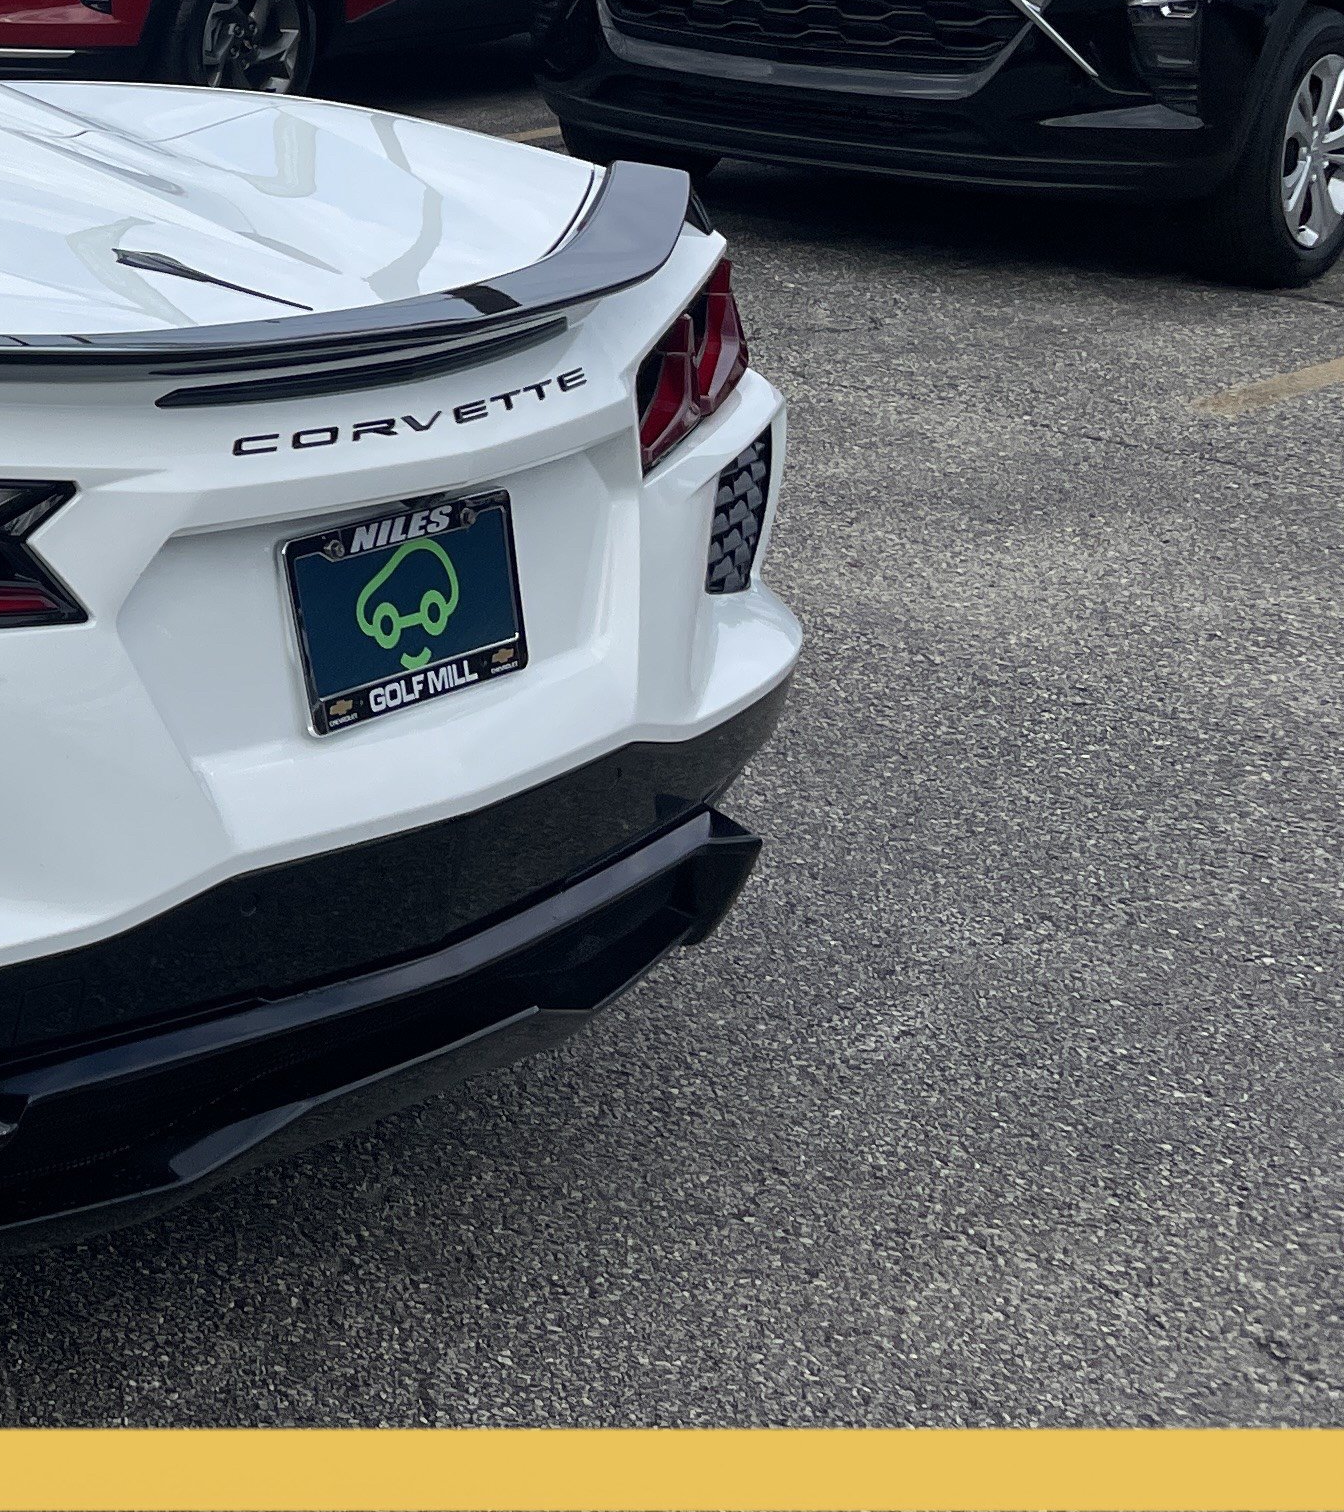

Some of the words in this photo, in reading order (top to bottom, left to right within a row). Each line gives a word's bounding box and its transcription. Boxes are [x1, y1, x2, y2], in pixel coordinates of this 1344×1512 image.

[232, 367, 588, 457] CORVETTE
[349, 505, 451, 555] NILES
[369, 673, 425, 713] GOLF
[428, 660, 479, 694] MILL
